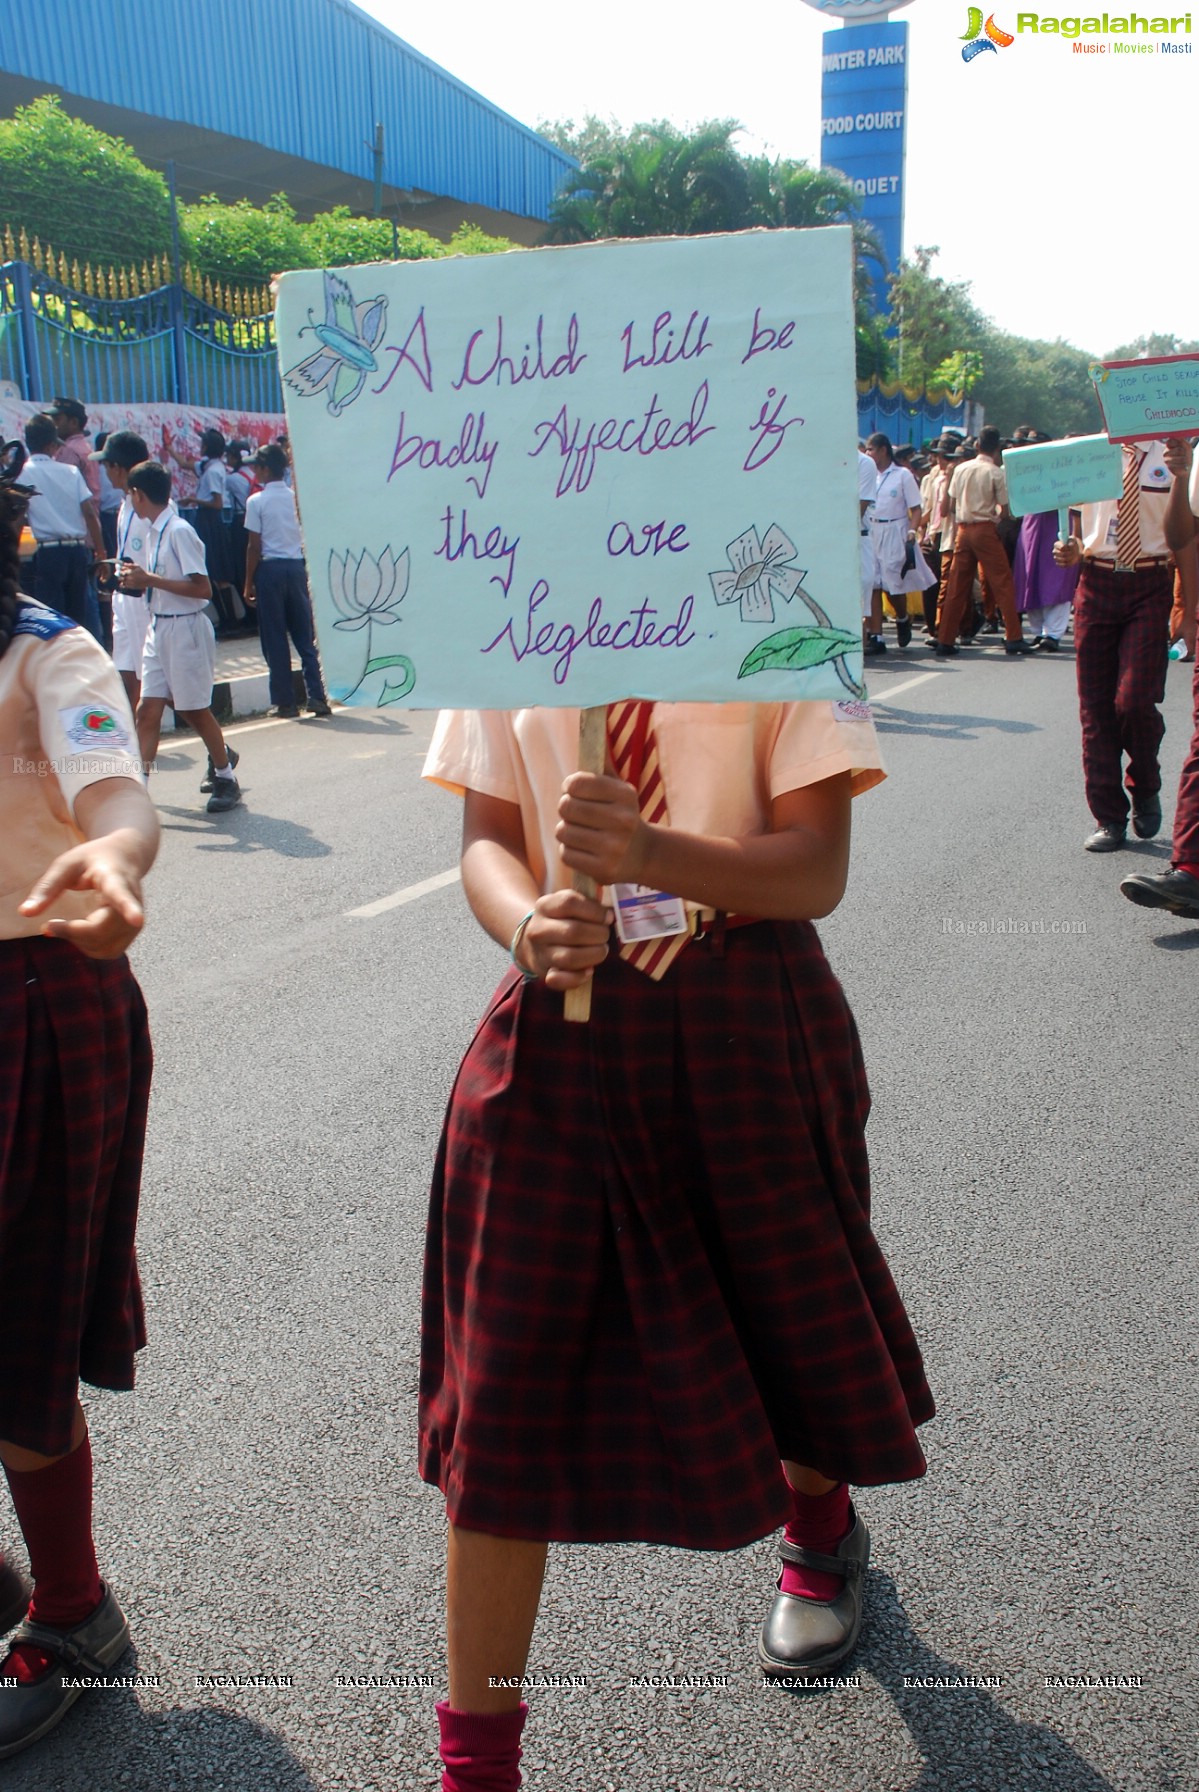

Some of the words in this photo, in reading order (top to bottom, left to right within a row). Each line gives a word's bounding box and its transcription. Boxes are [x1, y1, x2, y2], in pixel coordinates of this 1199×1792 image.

[822, 50, 866, 73] WATER
[867, 45, 905, 67] PARK
[821, 115, 854, 136] FOOD
[855, 111, 903, 132] COURT
[372, 306, 433, 394] A
[452, 312, 588, 391] Child
[622, 310, 713, 373] Will
[742, 307, 797, 365] be
[387, 411, 499, 499] badly
[527, 379, 716, 499] Affected
[743, 387, 805, 471] if
[434, 505, 520, 598] they
[607, 520, 690, 557] are
